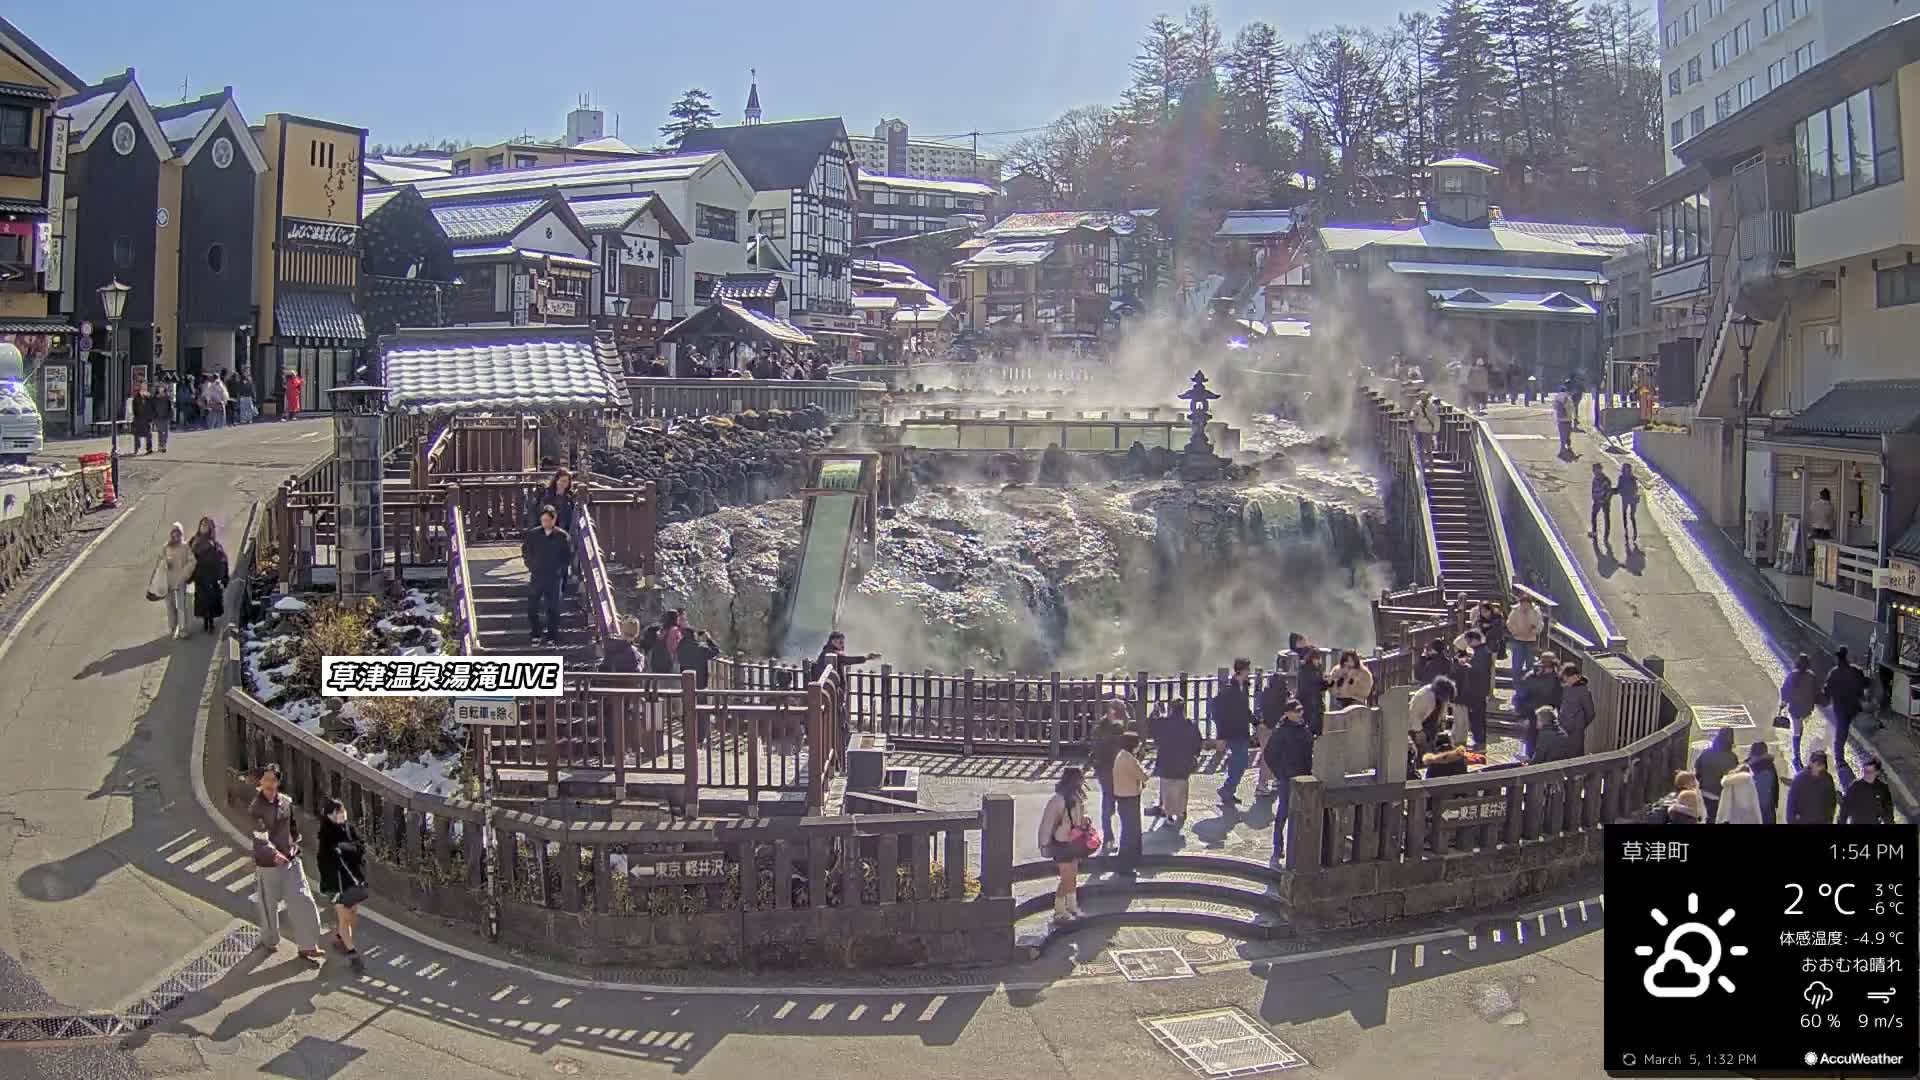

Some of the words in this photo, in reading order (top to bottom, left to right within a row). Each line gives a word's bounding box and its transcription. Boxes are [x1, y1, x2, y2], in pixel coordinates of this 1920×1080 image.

[655, 860, 681, 880] 東京
[686, 859, 725, 877] 軽井沢
